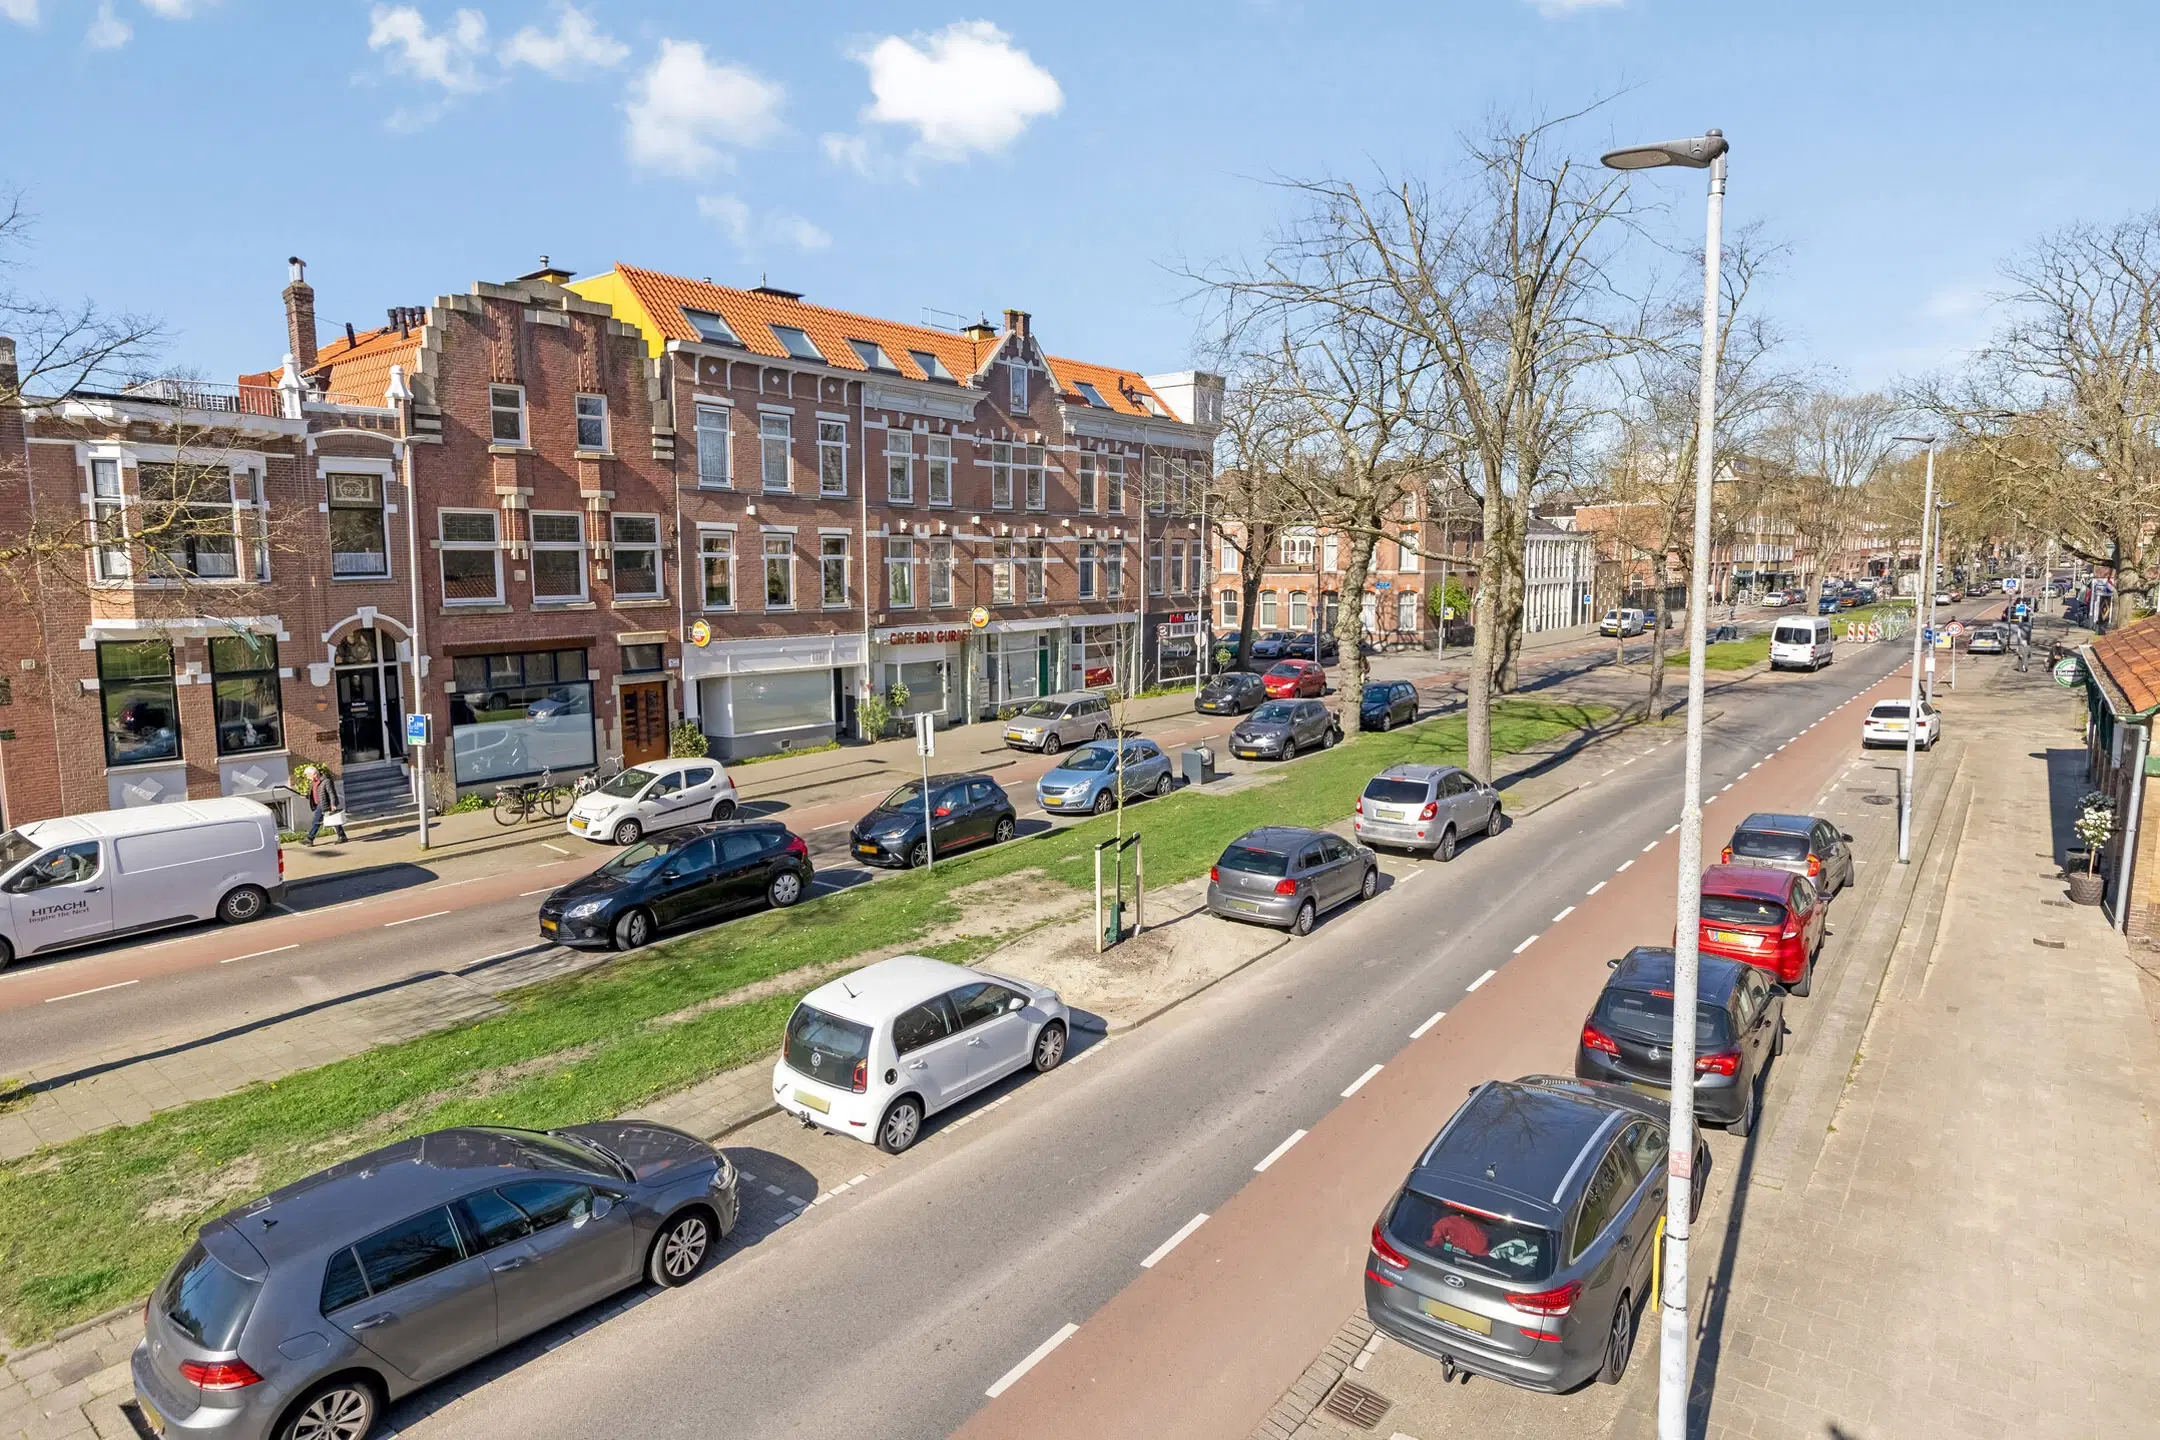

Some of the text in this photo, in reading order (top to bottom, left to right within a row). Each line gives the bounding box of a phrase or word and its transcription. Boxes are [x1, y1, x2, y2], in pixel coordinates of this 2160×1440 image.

[890, 632, 914, 645] CAFE
[916, 630, 935, 644] BAR
[29, 913, 56, 924] Inspire
[73, 907, 89, 915] Next
[31, 900, 86, 917] HITACHI
